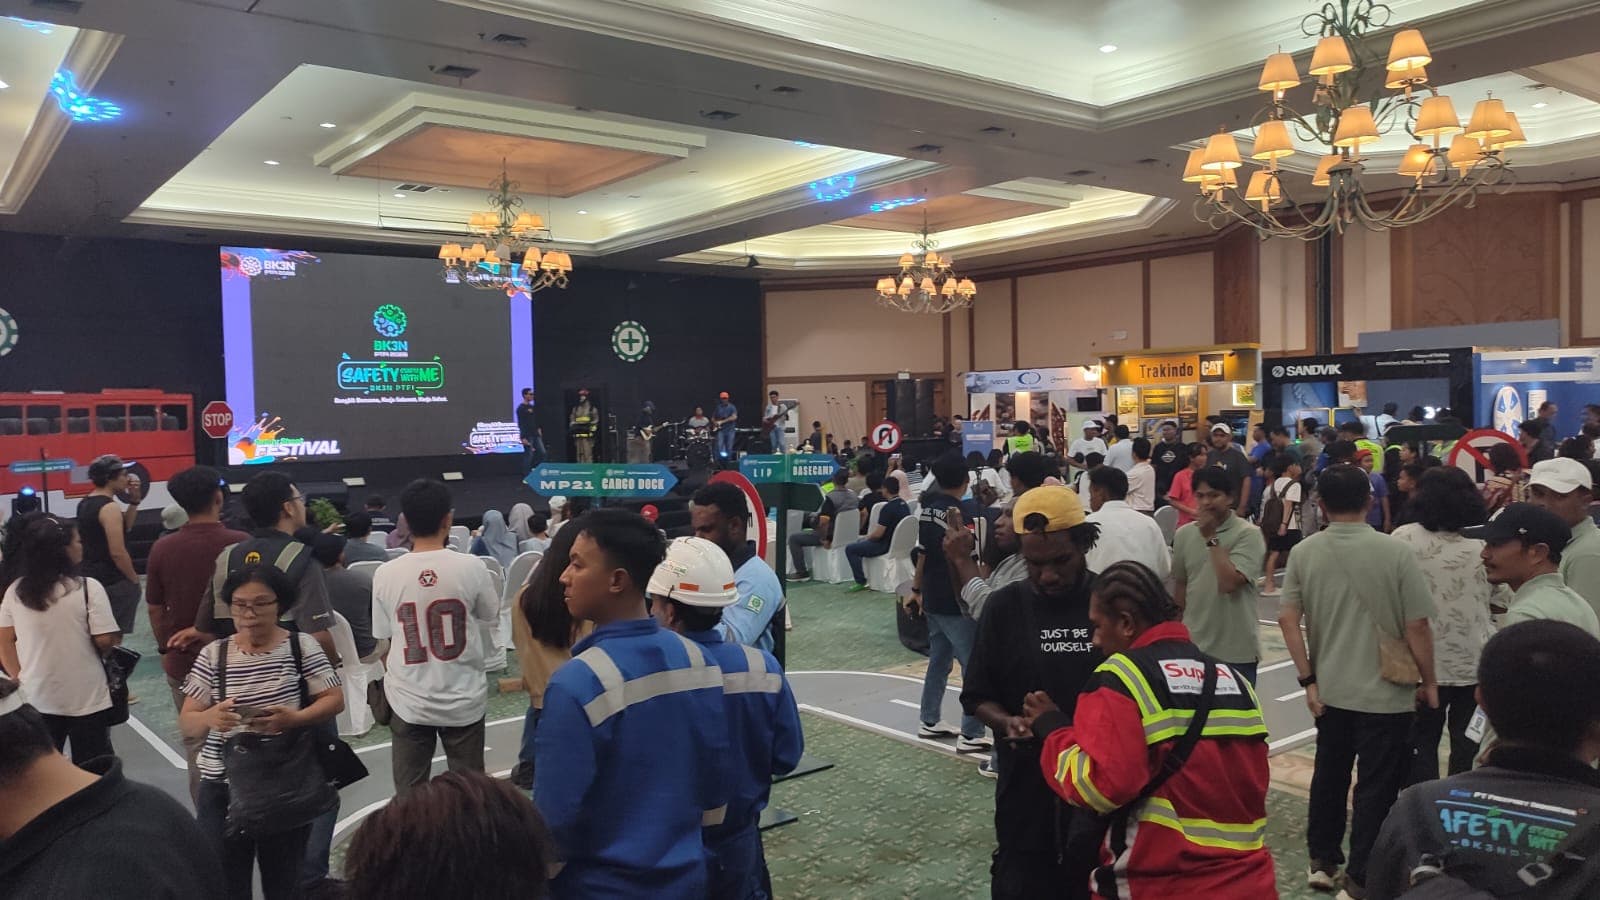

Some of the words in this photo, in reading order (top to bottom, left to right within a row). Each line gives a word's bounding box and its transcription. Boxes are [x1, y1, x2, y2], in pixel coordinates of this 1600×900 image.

[263, 260, 296, 271] BK3N
[373, 340, 409, 351] BK3N
[341, 366, 400, 383] SAFETY
[419, 366, 440, 382] ME
[1139, 362, 1193, 378] Trakindo
[1201, 360, 1224, 376] CAT
[1286, 363, 1343, 376] SANDVIK
[204, 412, 233, 427] STOP
[254, 440, 341, 457] FESTIVAL
[792, 465, 834, 476] BASECAMP
[540, 480, 595, 490] MP21
[601, 477, 635, 490] CARGO
[638, 477, 665, 490] DOCK
[397, 598, 467, 665] 10
[1040, 628, 1070, 640] JUST
[1071, 628, 1089, 639] BE
[1440, 808, 1527, 846] AFETY
